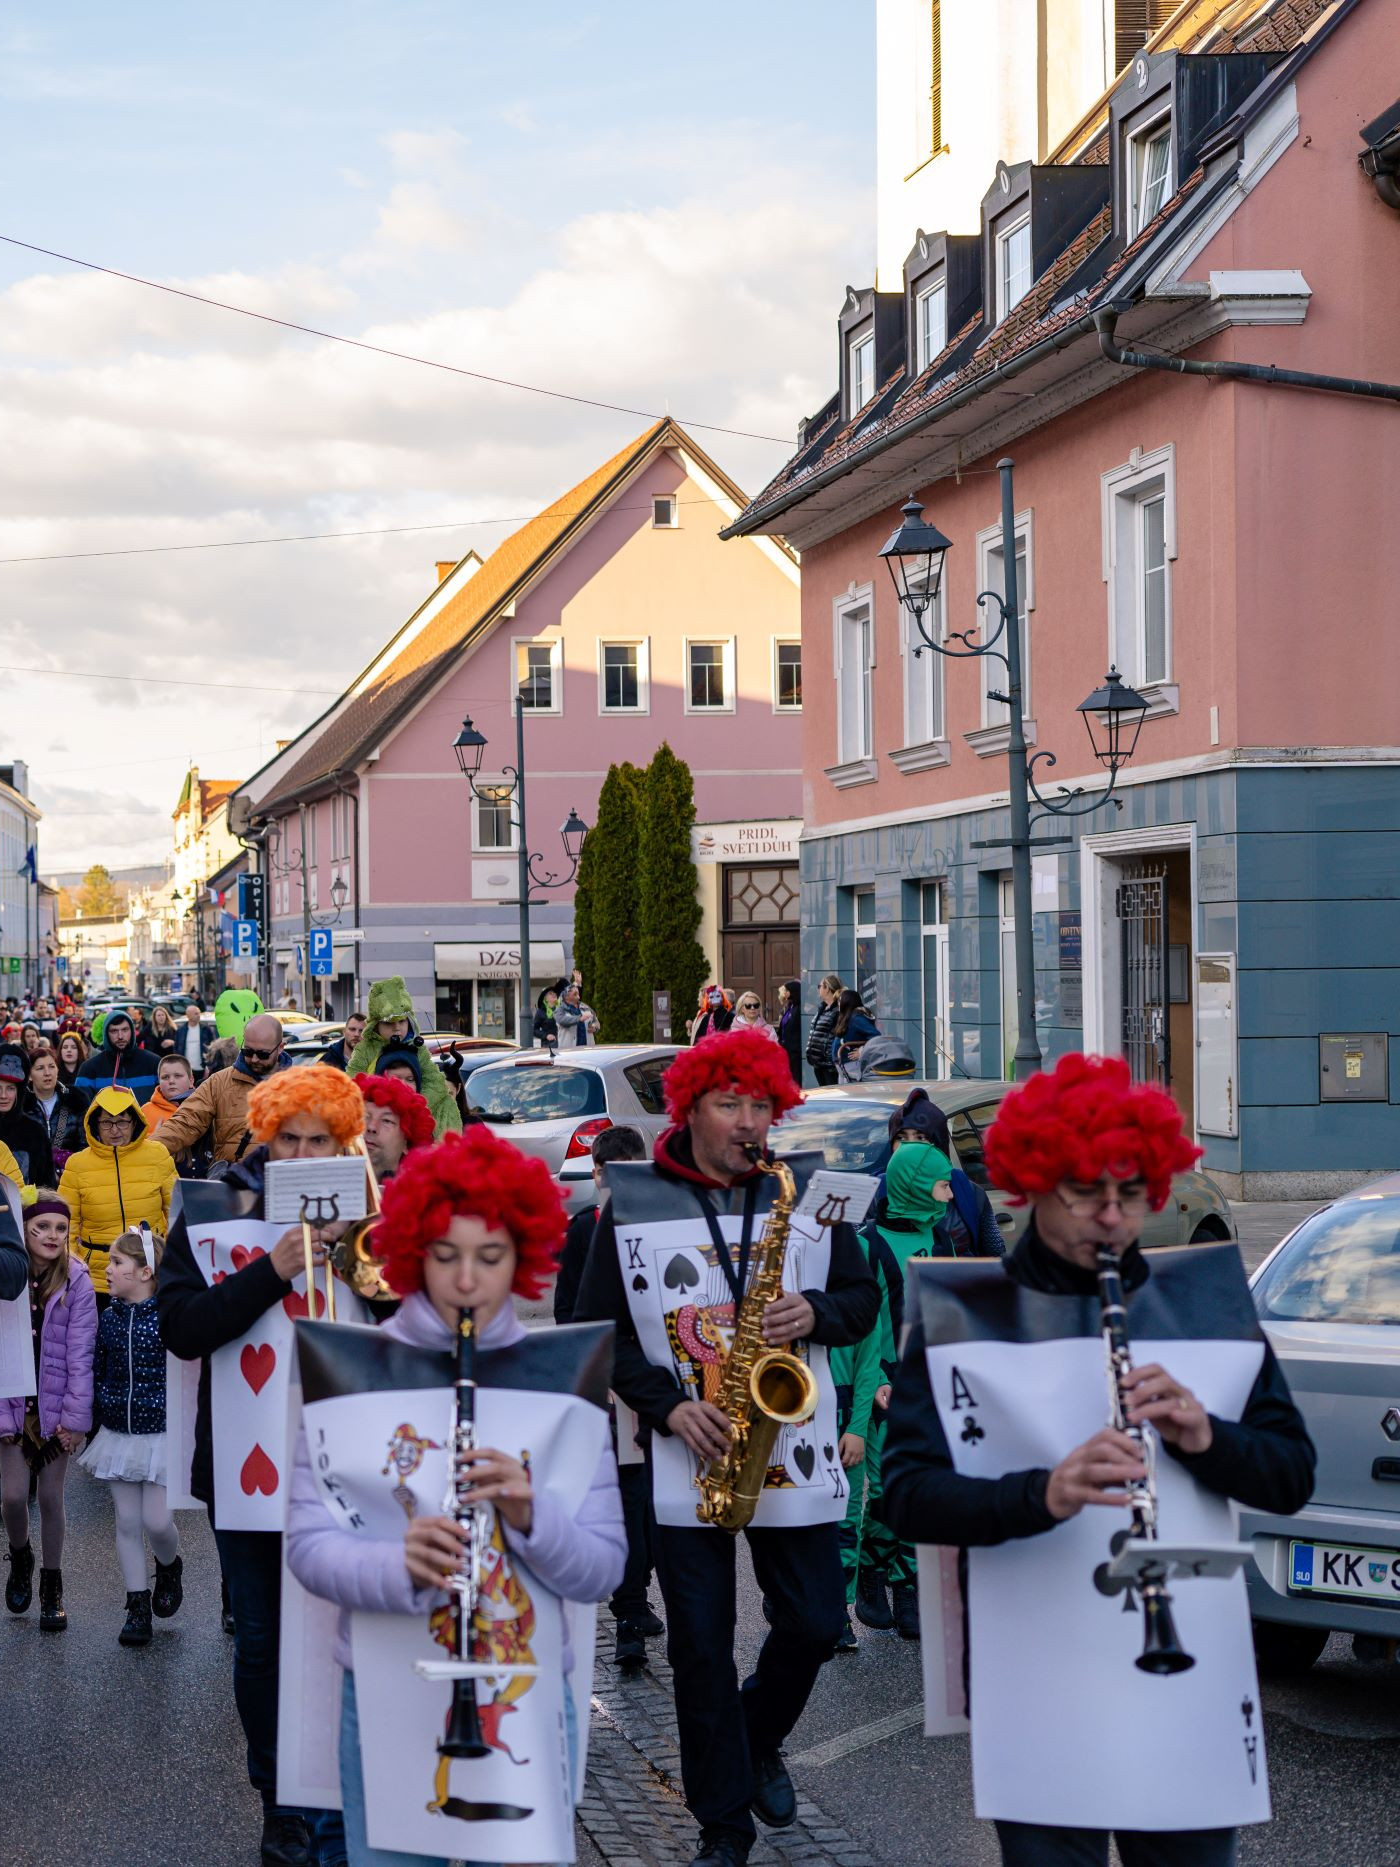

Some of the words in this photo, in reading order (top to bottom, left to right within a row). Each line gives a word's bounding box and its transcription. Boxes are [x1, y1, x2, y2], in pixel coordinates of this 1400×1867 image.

[1136, 59, 1146, 89] 2
[723, 842, 759, 854] SVETI
[762, 841, 791, 853] DUH
[738, 828, 778, 840] PRIDI,
[238, 923, 252, 942] P
[314, 932, 328, 956] P
[479, 951, 521, 967] DZS
[477, 971, 521, 979] KNJIGARN
[198, 1237, 216, 1268] 7
[625, 1237, 646, 1269] K
[950, 1366, 979, 1410] A
[827, 1468, 844, 1499] K
[1296, 1571, 1311, 1581] SLO
[1323, 1552, 1365, 1587] KK
[1243, 1736, 1257, 1786] A
